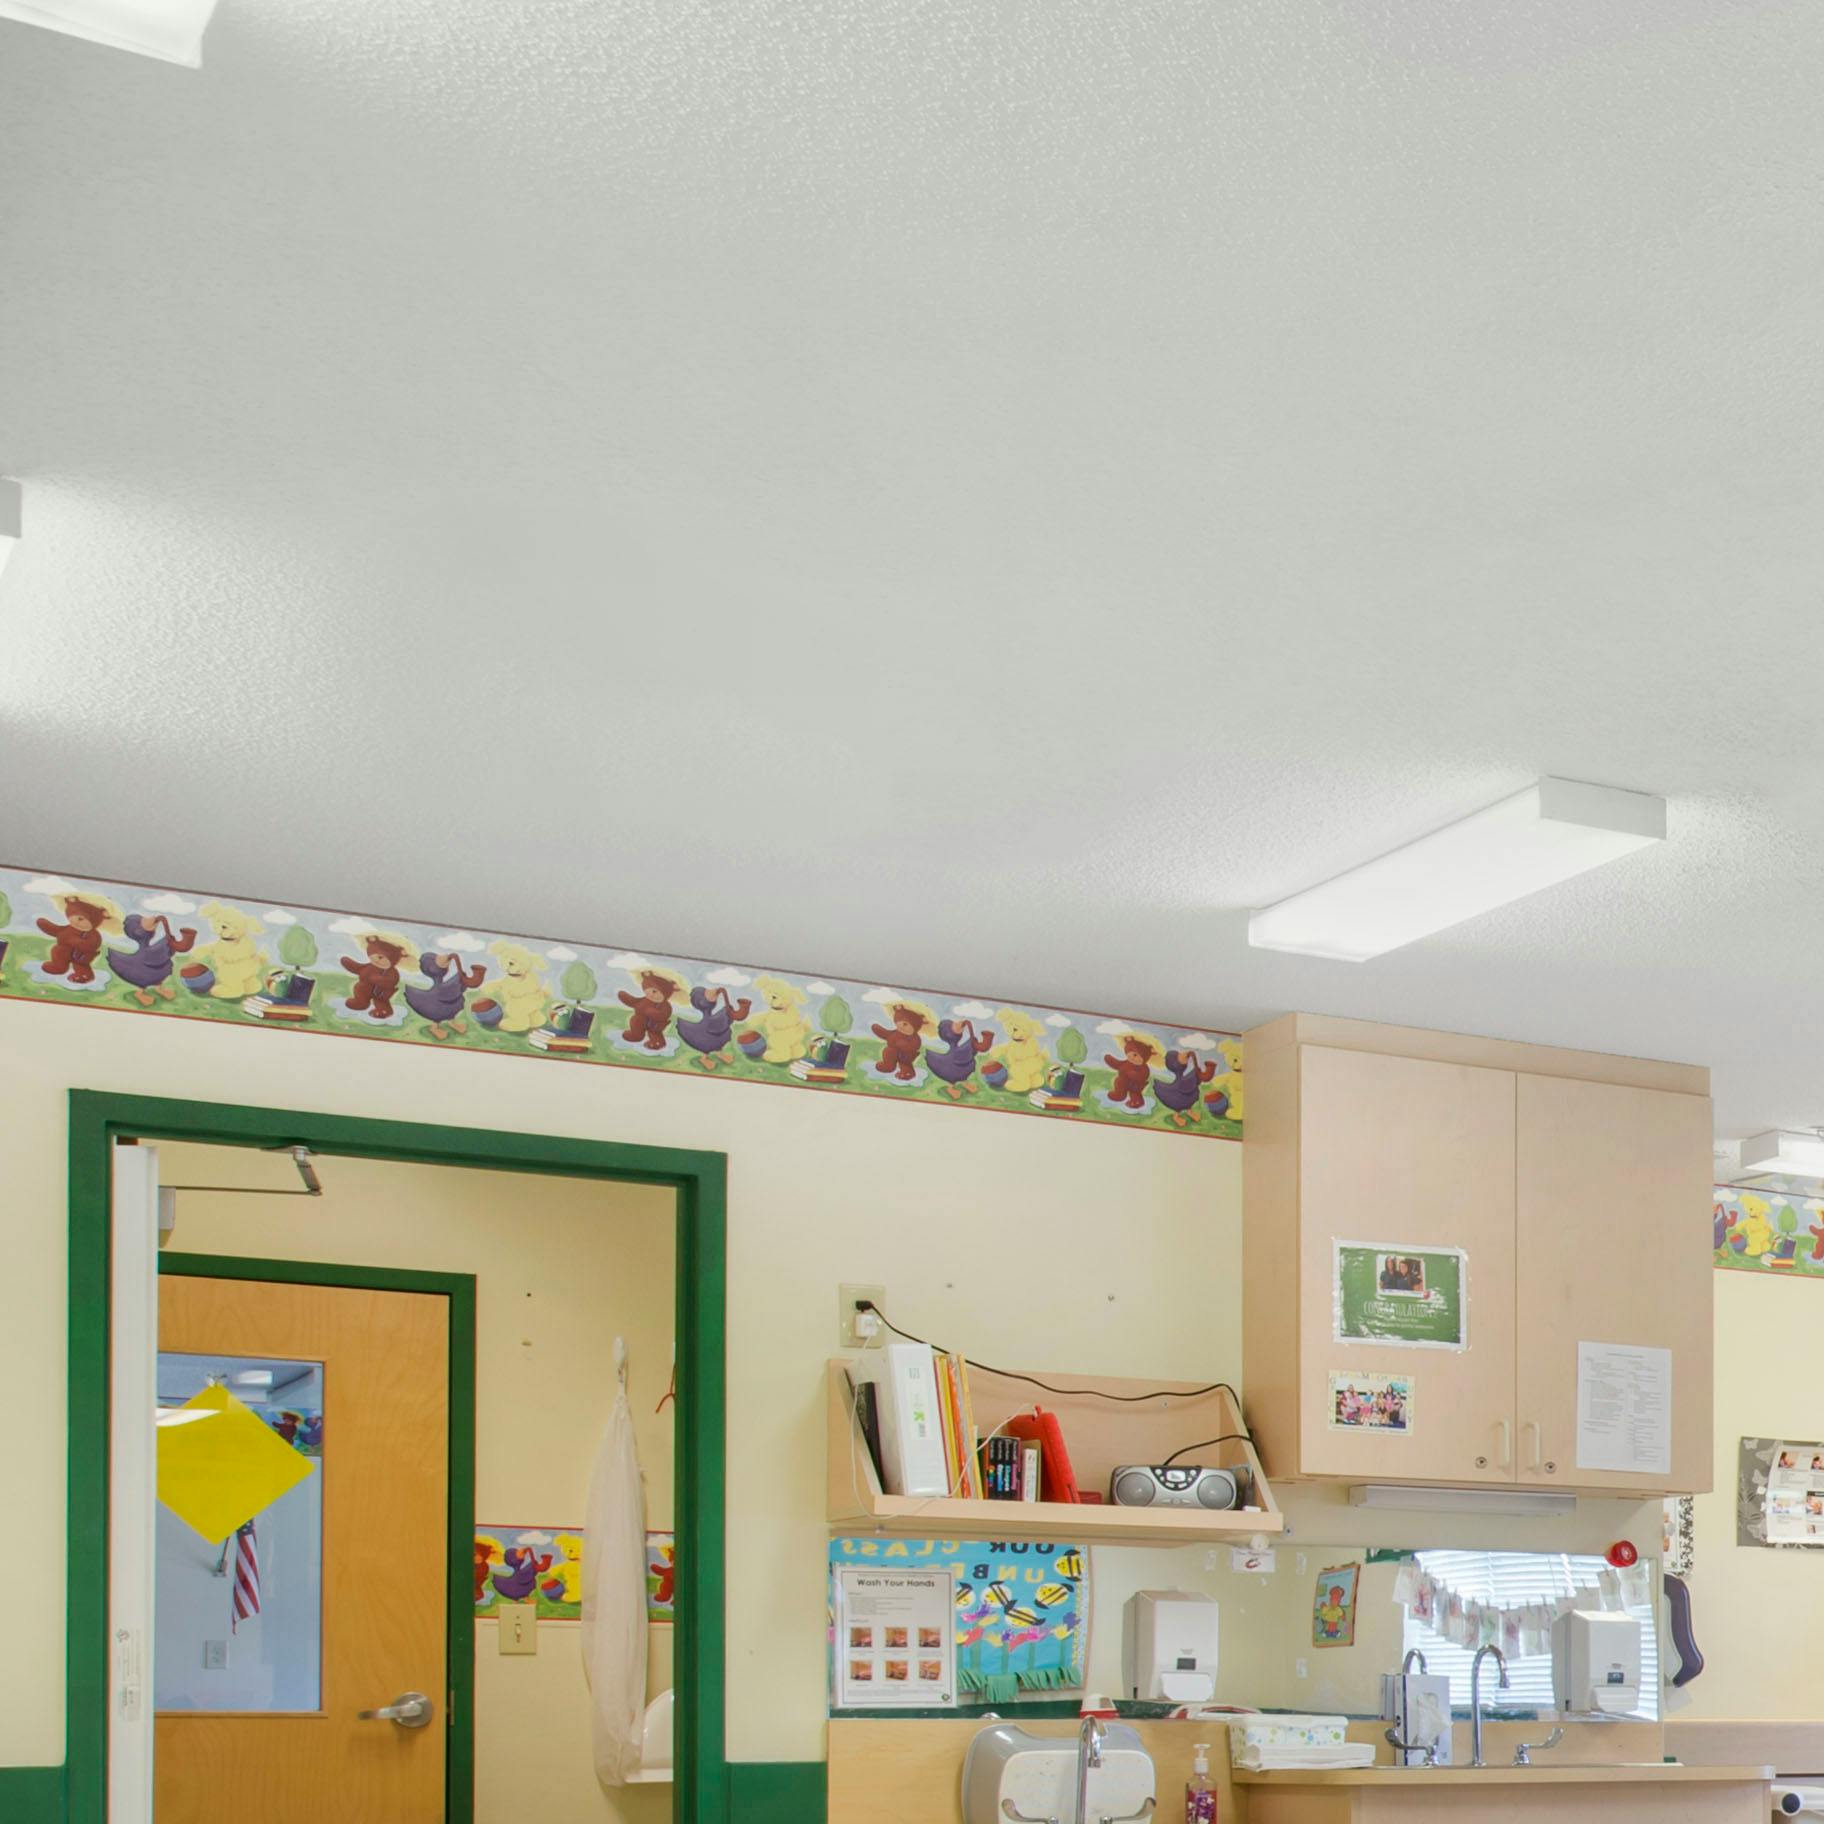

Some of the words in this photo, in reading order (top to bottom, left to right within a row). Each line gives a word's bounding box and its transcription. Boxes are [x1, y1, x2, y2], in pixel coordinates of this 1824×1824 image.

[857, 1579, 881, 1588] Wash
[885, 1580, 904, 1588] Your
[907, 1580, 935, 1588] Hands
